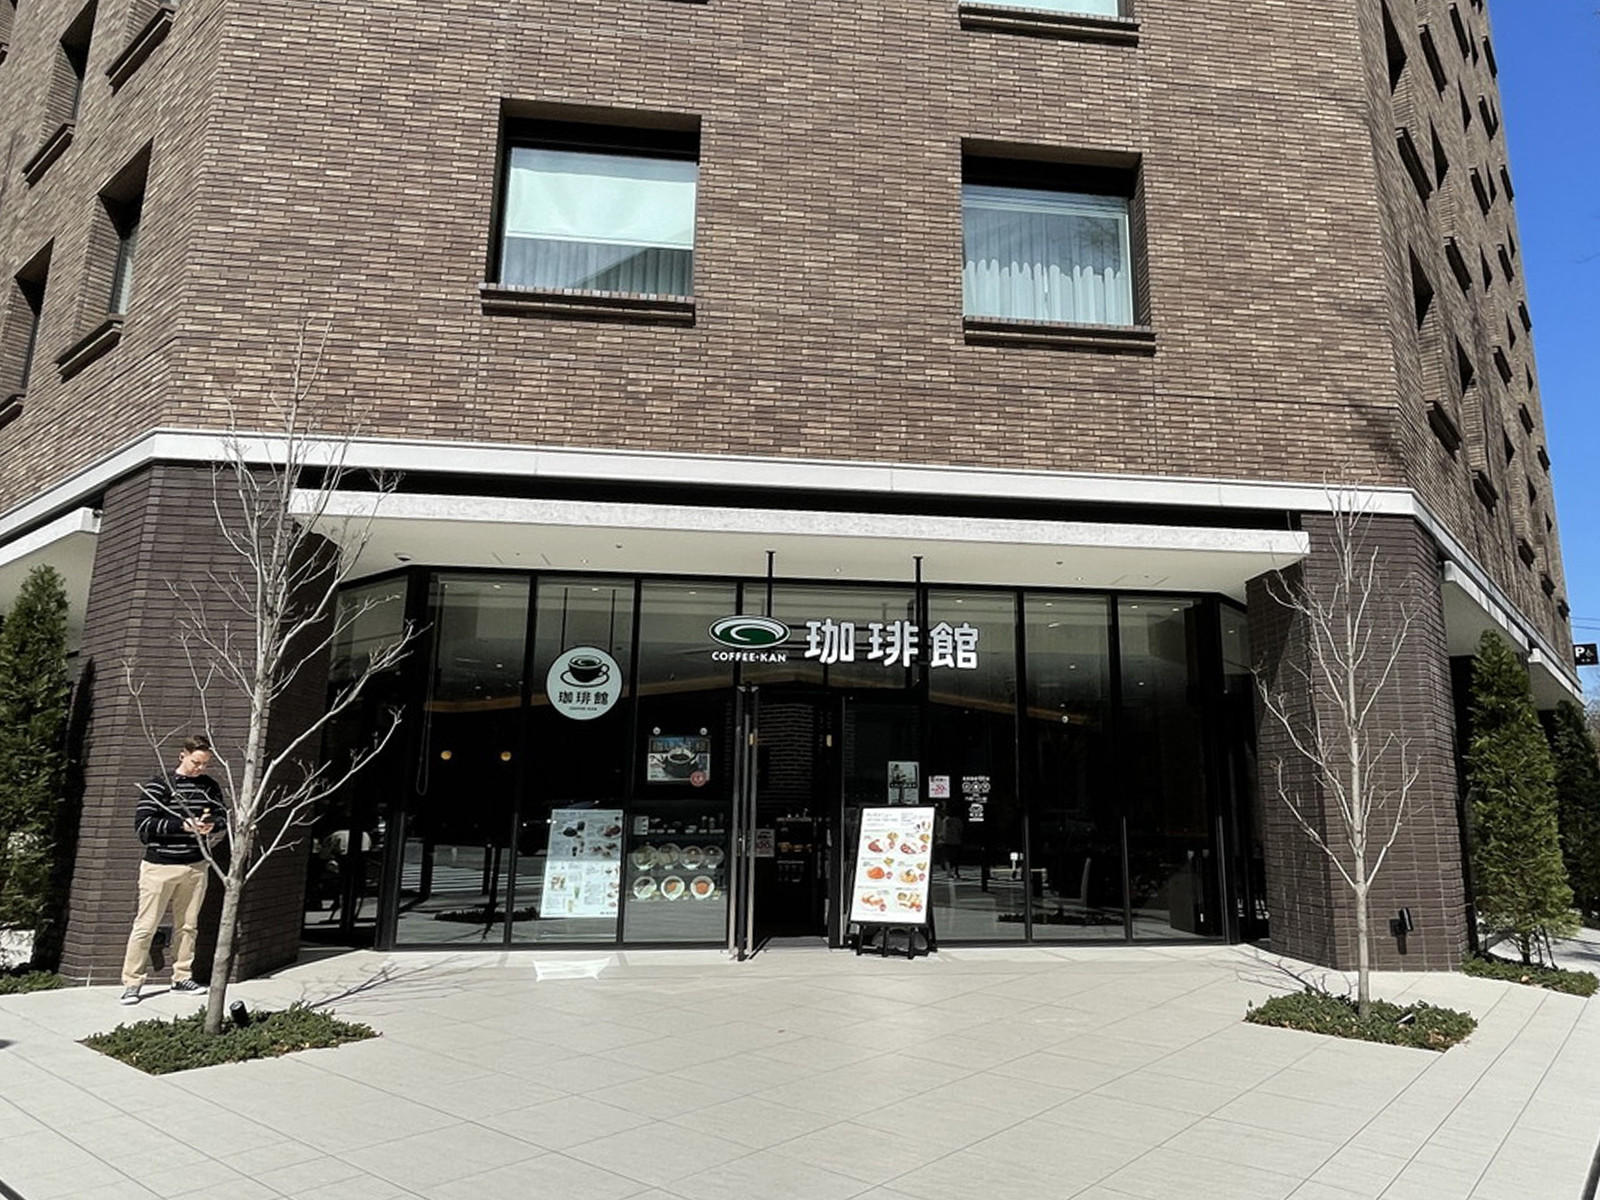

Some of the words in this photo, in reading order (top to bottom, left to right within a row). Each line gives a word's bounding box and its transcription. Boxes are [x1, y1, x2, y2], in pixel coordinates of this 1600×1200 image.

[804, 618, 979, 669] 珈琲館
[1575, 646, 1585, 658] P
[558, 690, 609, 705] 珈琲館
